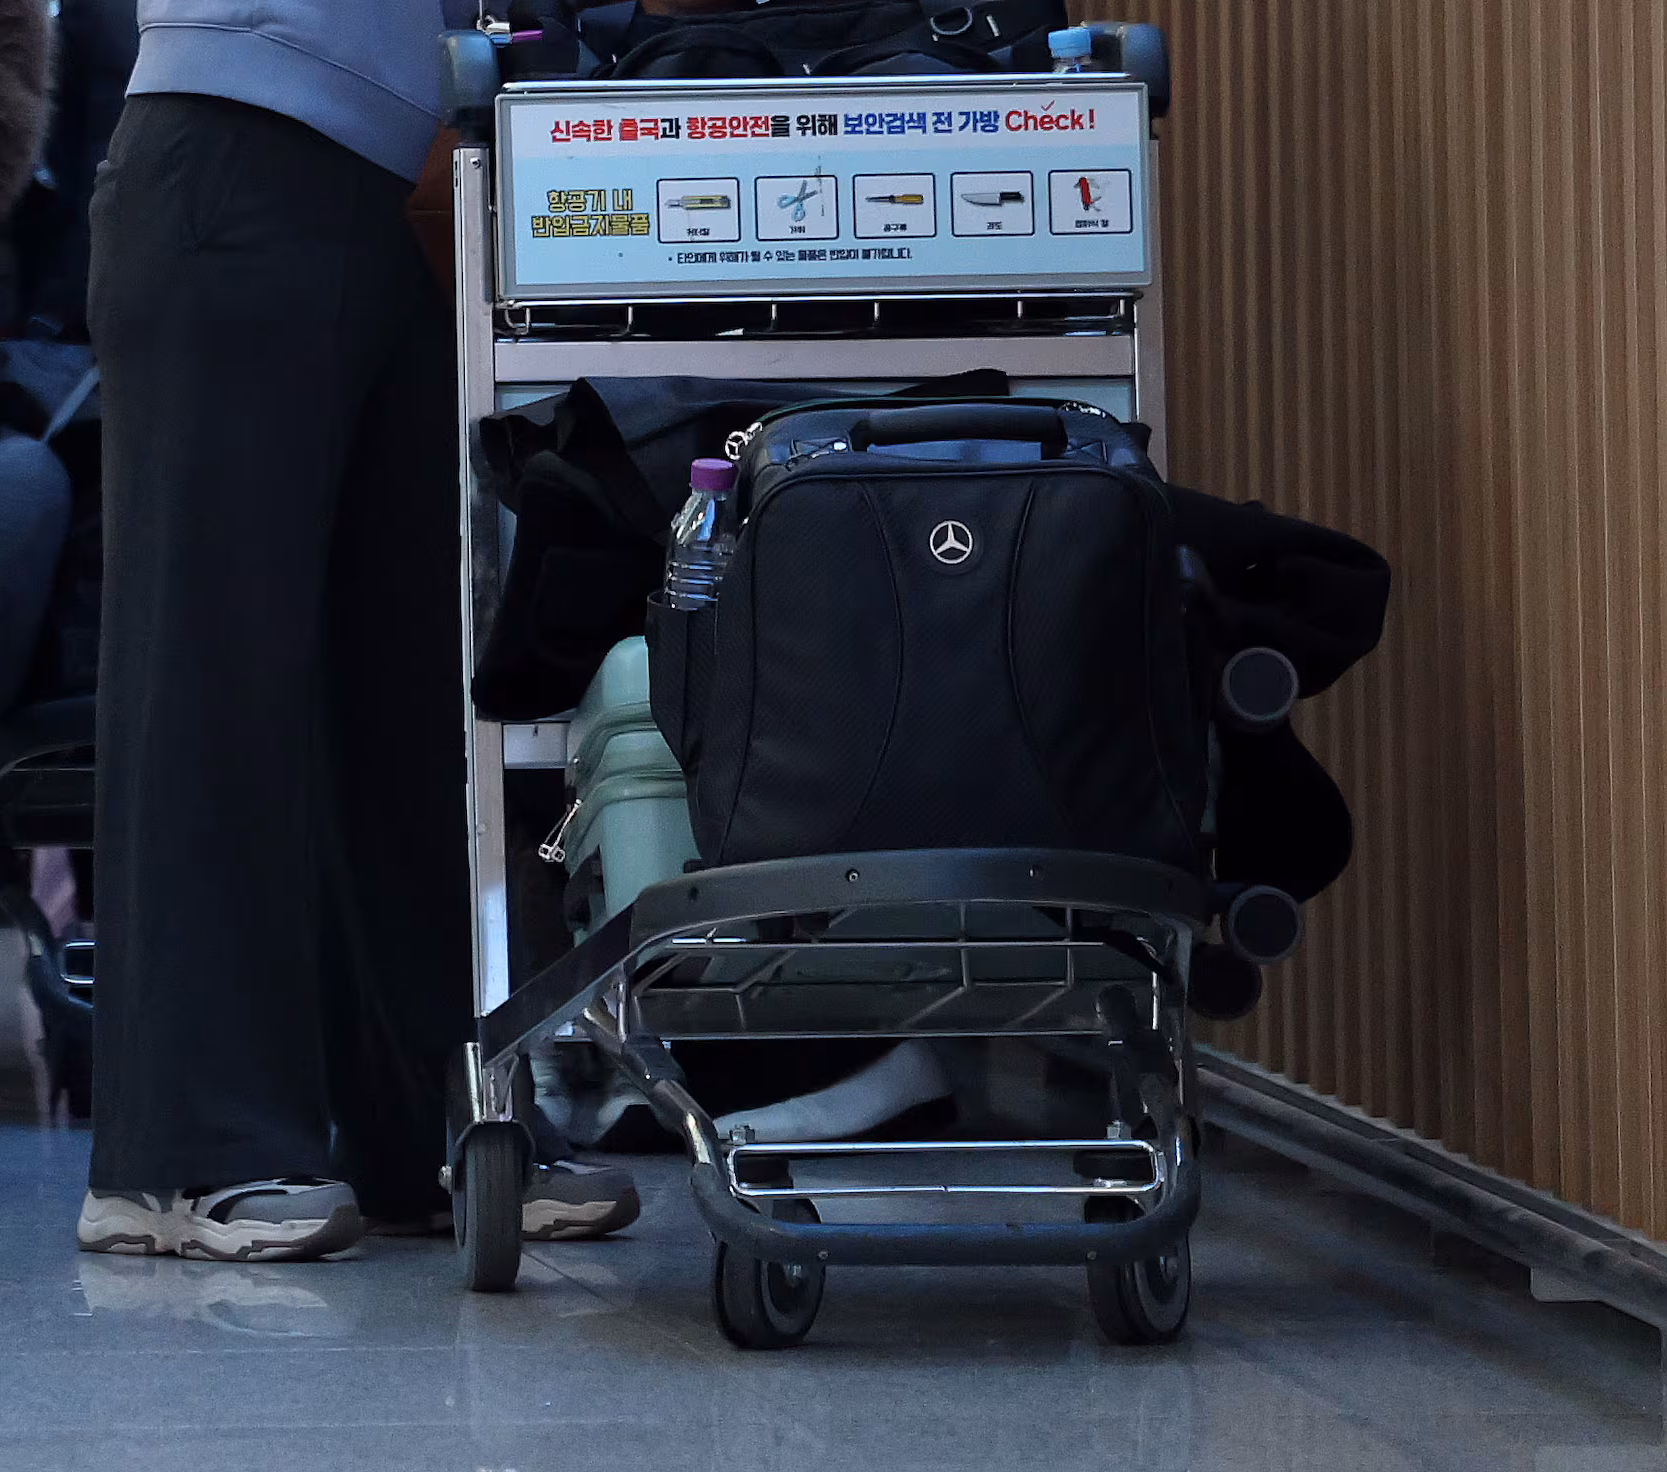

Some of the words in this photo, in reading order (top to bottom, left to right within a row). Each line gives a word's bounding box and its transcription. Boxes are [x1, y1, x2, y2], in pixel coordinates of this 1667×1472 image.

[550, 119, 614, 143] 신속한
[618, 117, 681, 142] 출국과
[686, 115, 790, 140] 항공안전을
[796, 114, 838, 137] 위해
[843, 112, 927, 135] 보안검색
[932, 111, 953, 134] 전
[958, 110, 1000, 133] 가방
[547, 190, 606, 213] 항공기
[612, 189, 633, 211] 내
[531, 213, 650, 238] 반입금지물품
[763, 250, 773, 261] 수
[775, 249, 795, 261] 있는
